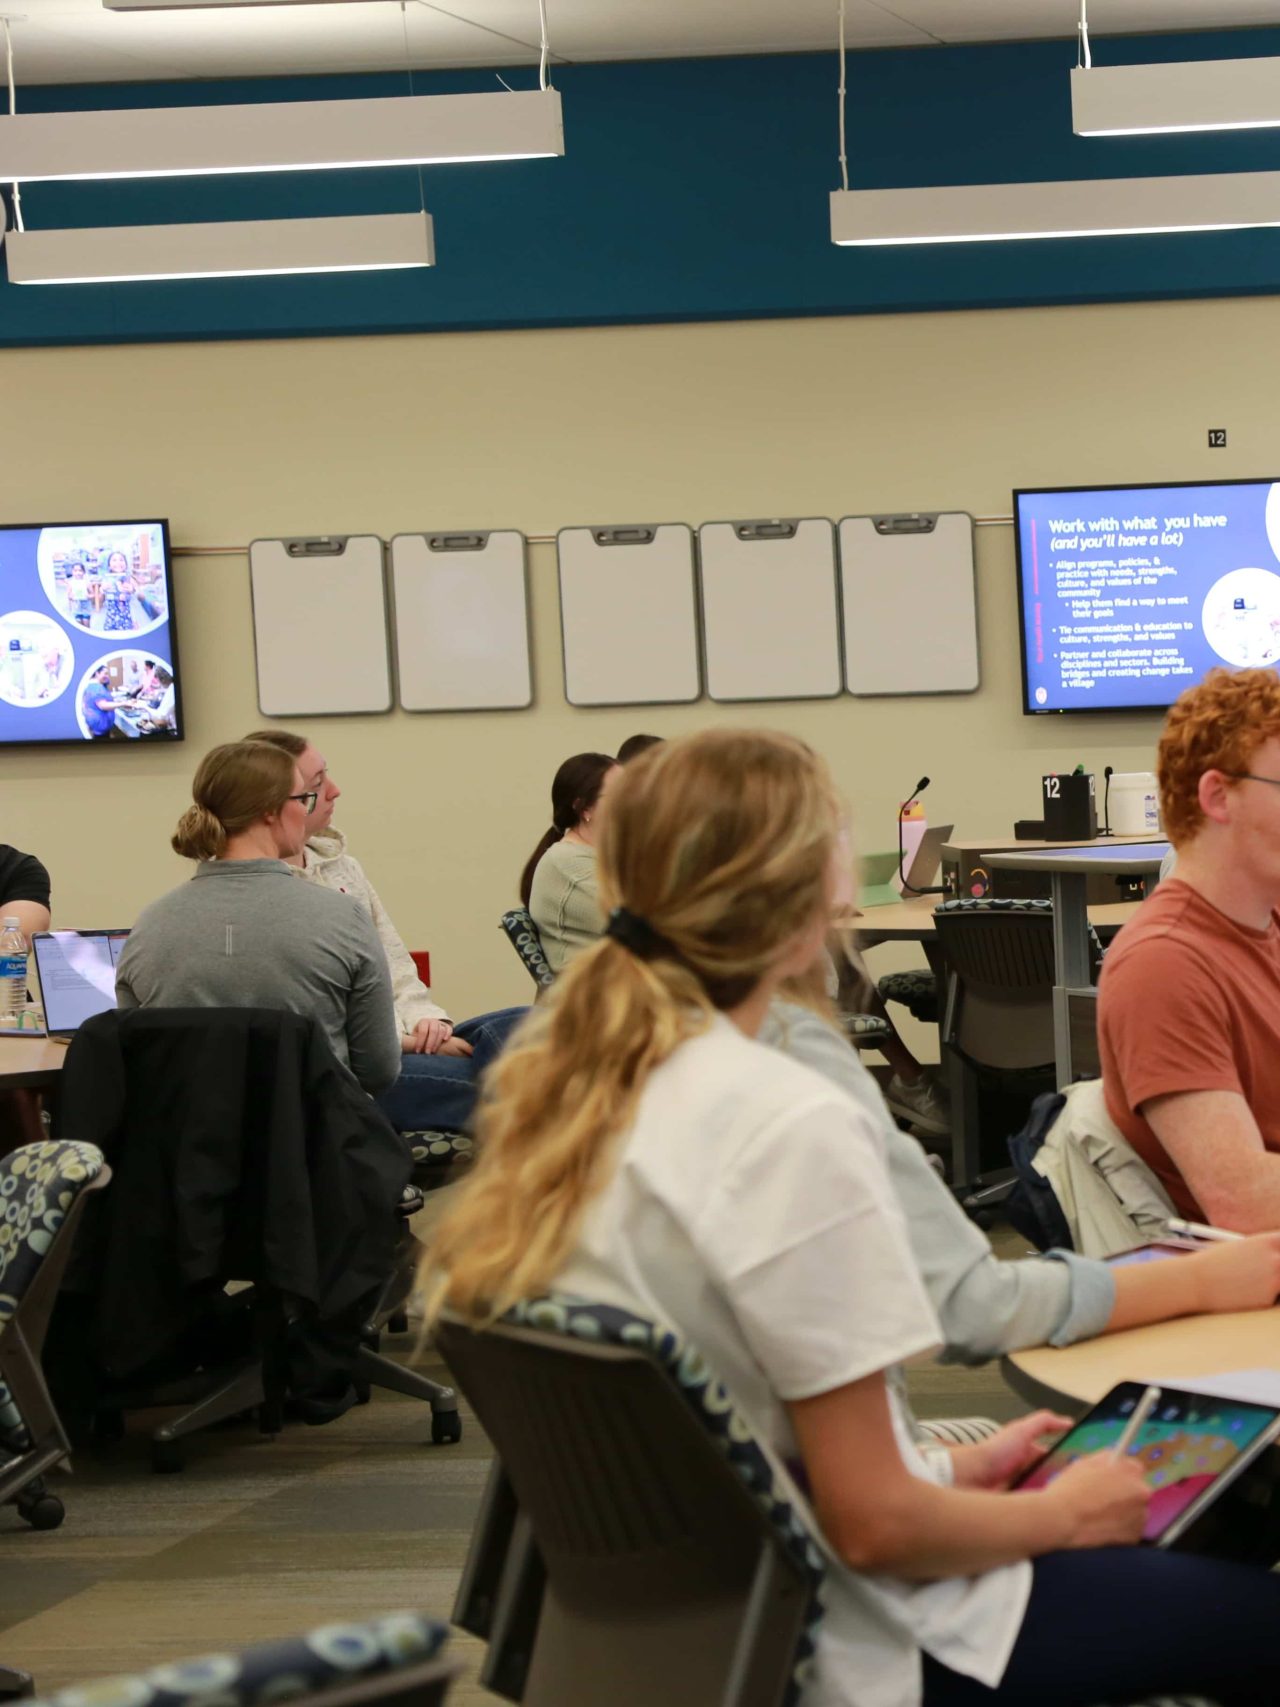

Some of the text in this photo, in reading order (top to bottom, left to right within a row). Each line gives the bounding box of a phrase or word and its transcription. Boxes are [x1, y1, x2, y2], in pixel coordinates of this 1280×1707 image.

[1210, 432, 1225, 445] 12
[1049, 513, 1227, 534] Work with what you have
[1051, 532, 1183, 552] (and you'll have a lot)
[1056, 556, 1160, 570] Align programs, policies, &
[1057, 566, 1177, 580] practice with needs, strengths,
[1057, 576, 1157, 588] culture, and values of the
[1057, 588, 1100, 598] community
[1072, 600, 1090, 610] Help
[1092, 599, 1113, 608] them
[1115, 598, 1130, 607] find
[1140, 599, 1155, 607] way
[1158, 597, 1165, 605] to
[1168, 596, 1188, 605] meet
[1073, 608, 1113, 619] their goals
[1059, 626, 1072, 634] Tie
[1074, 624, 1132, 633] communication
[1143, 622, 1182, 631] education
[1060, 632, 1175, 644] culture, strengths, and values
[1061, 648, 1178, 660] Partner and collaborate across
[1061, 660, 1102, 670] disciplines
[1104, 659, 1117, 667] and
[1152, 657, 1184, 667] Building
[1061, 666, 1193, 679] bridges and creating change takes
[1062, 678, 1094, 689] a village
[1044, 778, 1060, 798] 12
